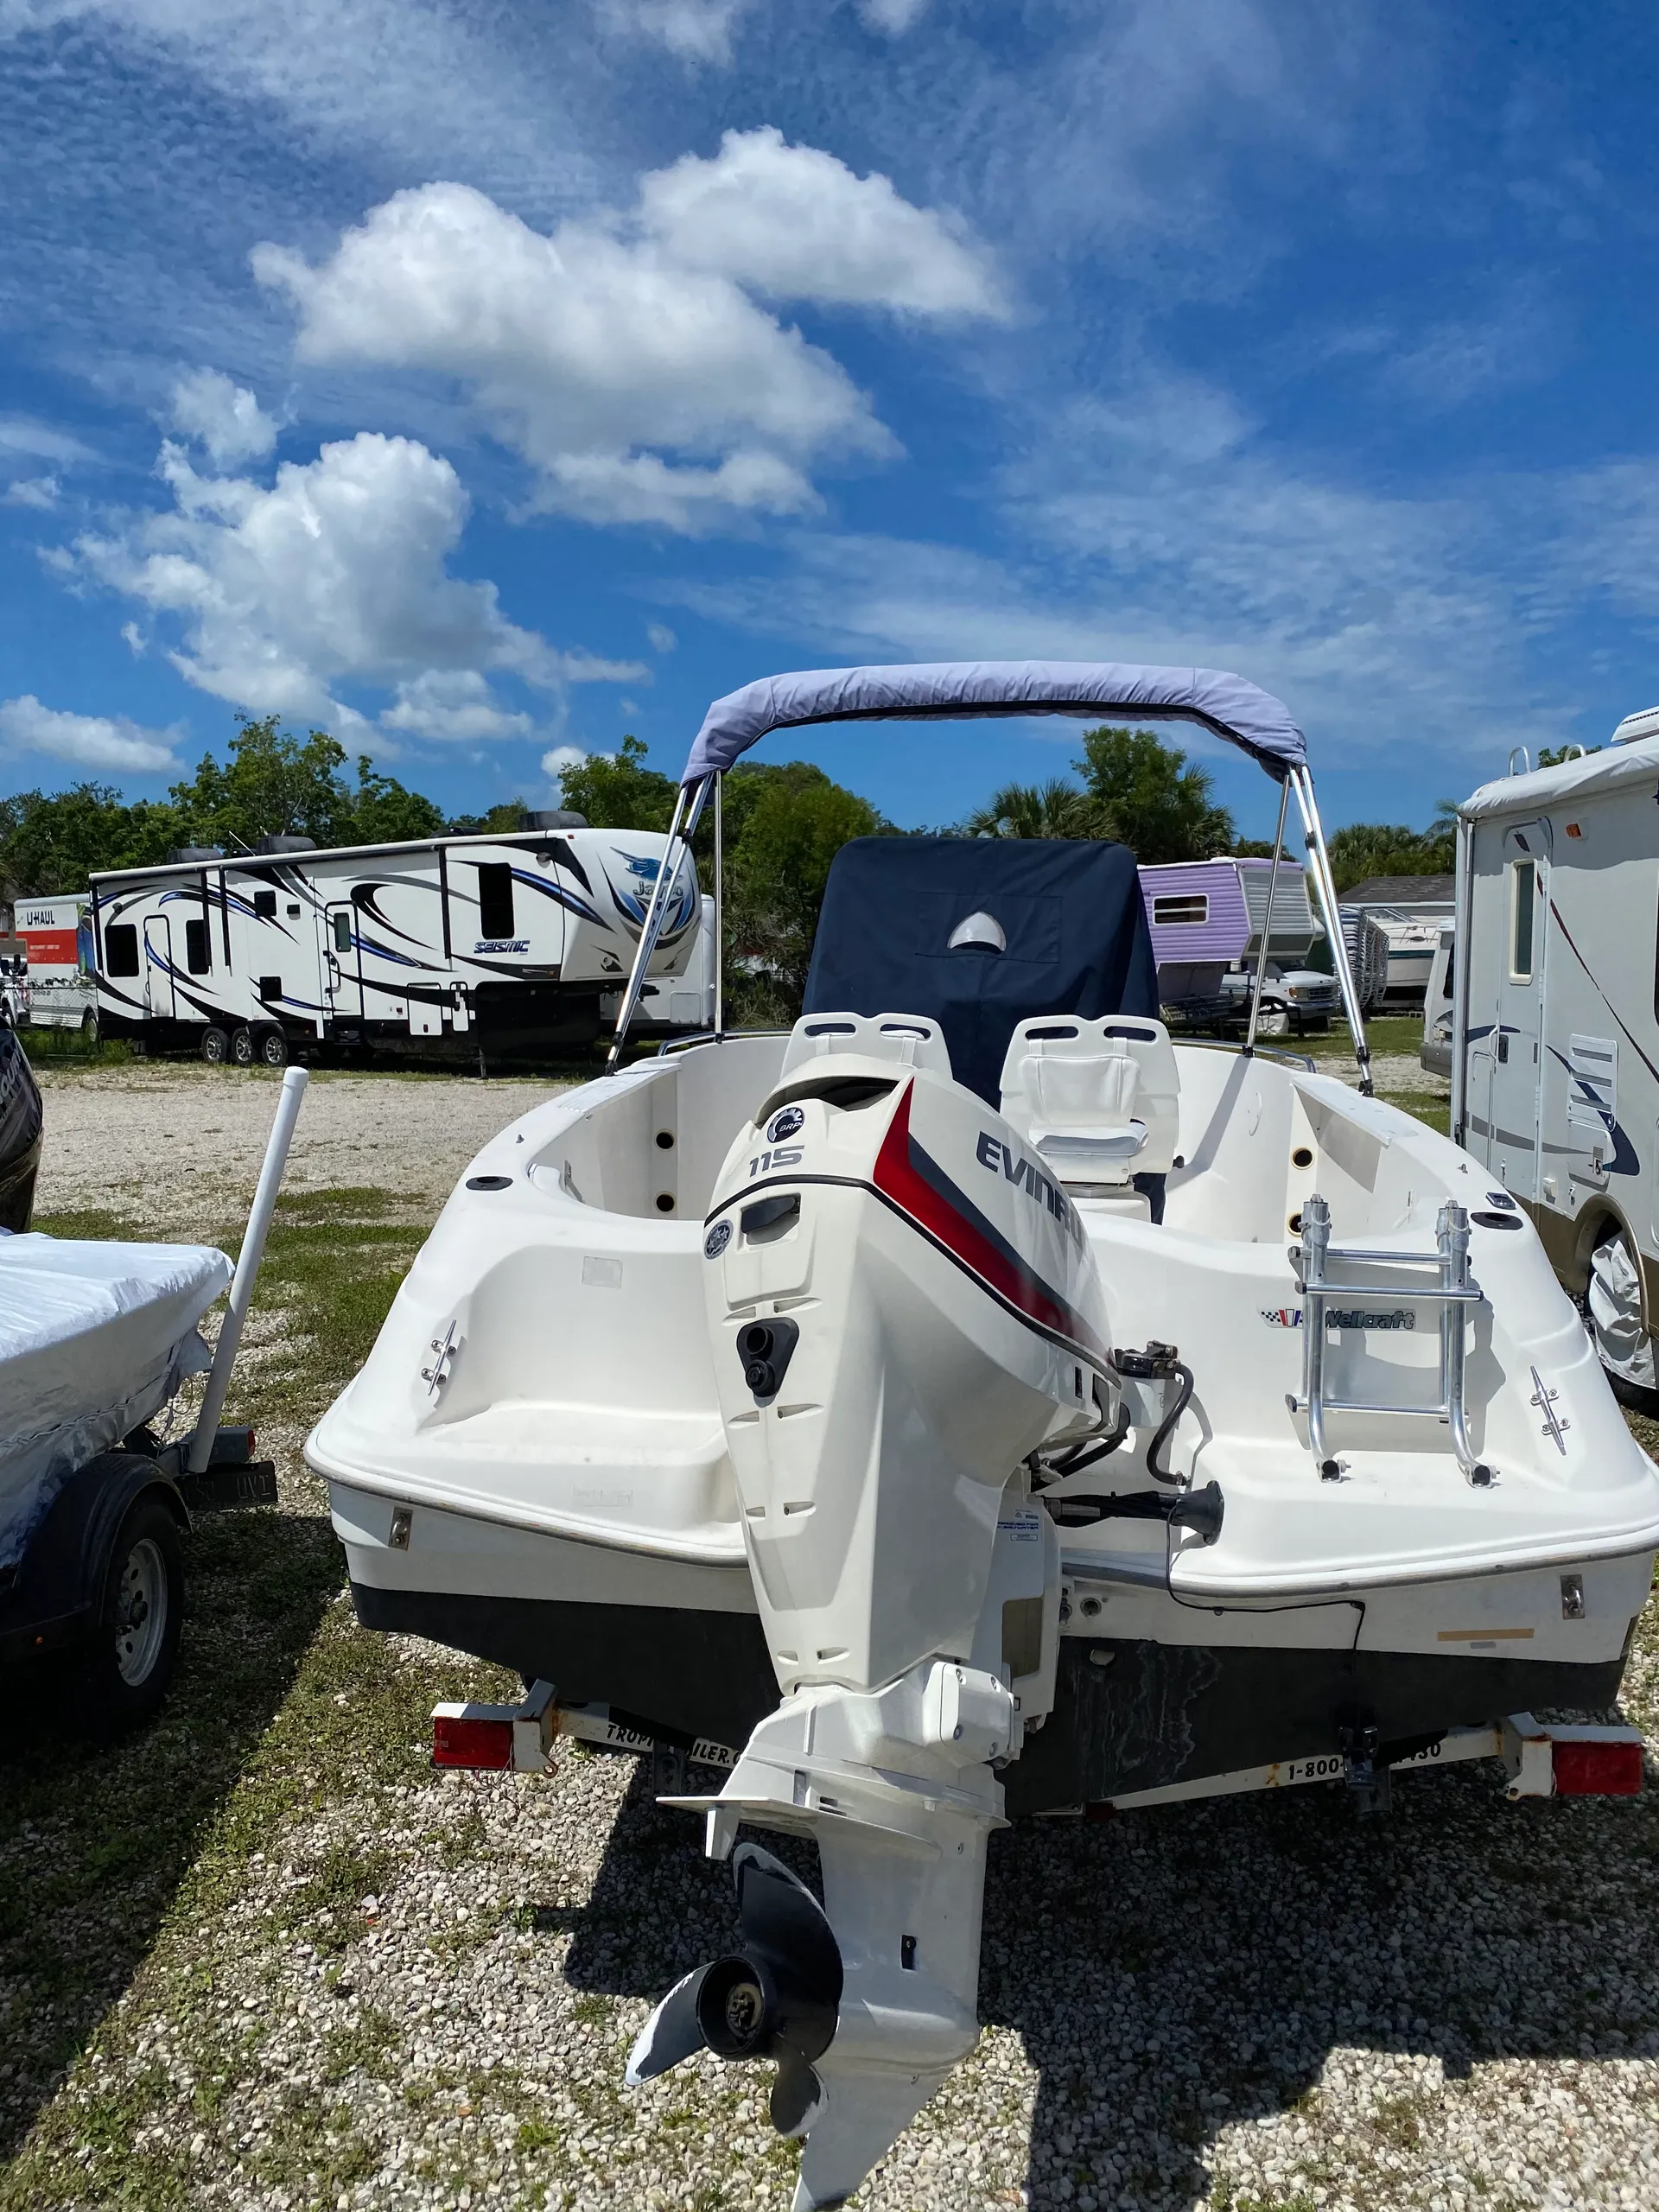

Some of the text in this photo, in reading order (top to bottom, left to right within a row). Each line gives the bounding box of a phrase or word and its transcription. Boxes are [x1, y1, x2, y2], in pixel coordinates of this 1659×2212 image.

[474, 940, 531, 953] SEISMIC
[779, 1122, 803, 1132] BRP
[749, 1145, 804, 1177] 115
[1325, 1310, 1414, 1329] Wellcraft
